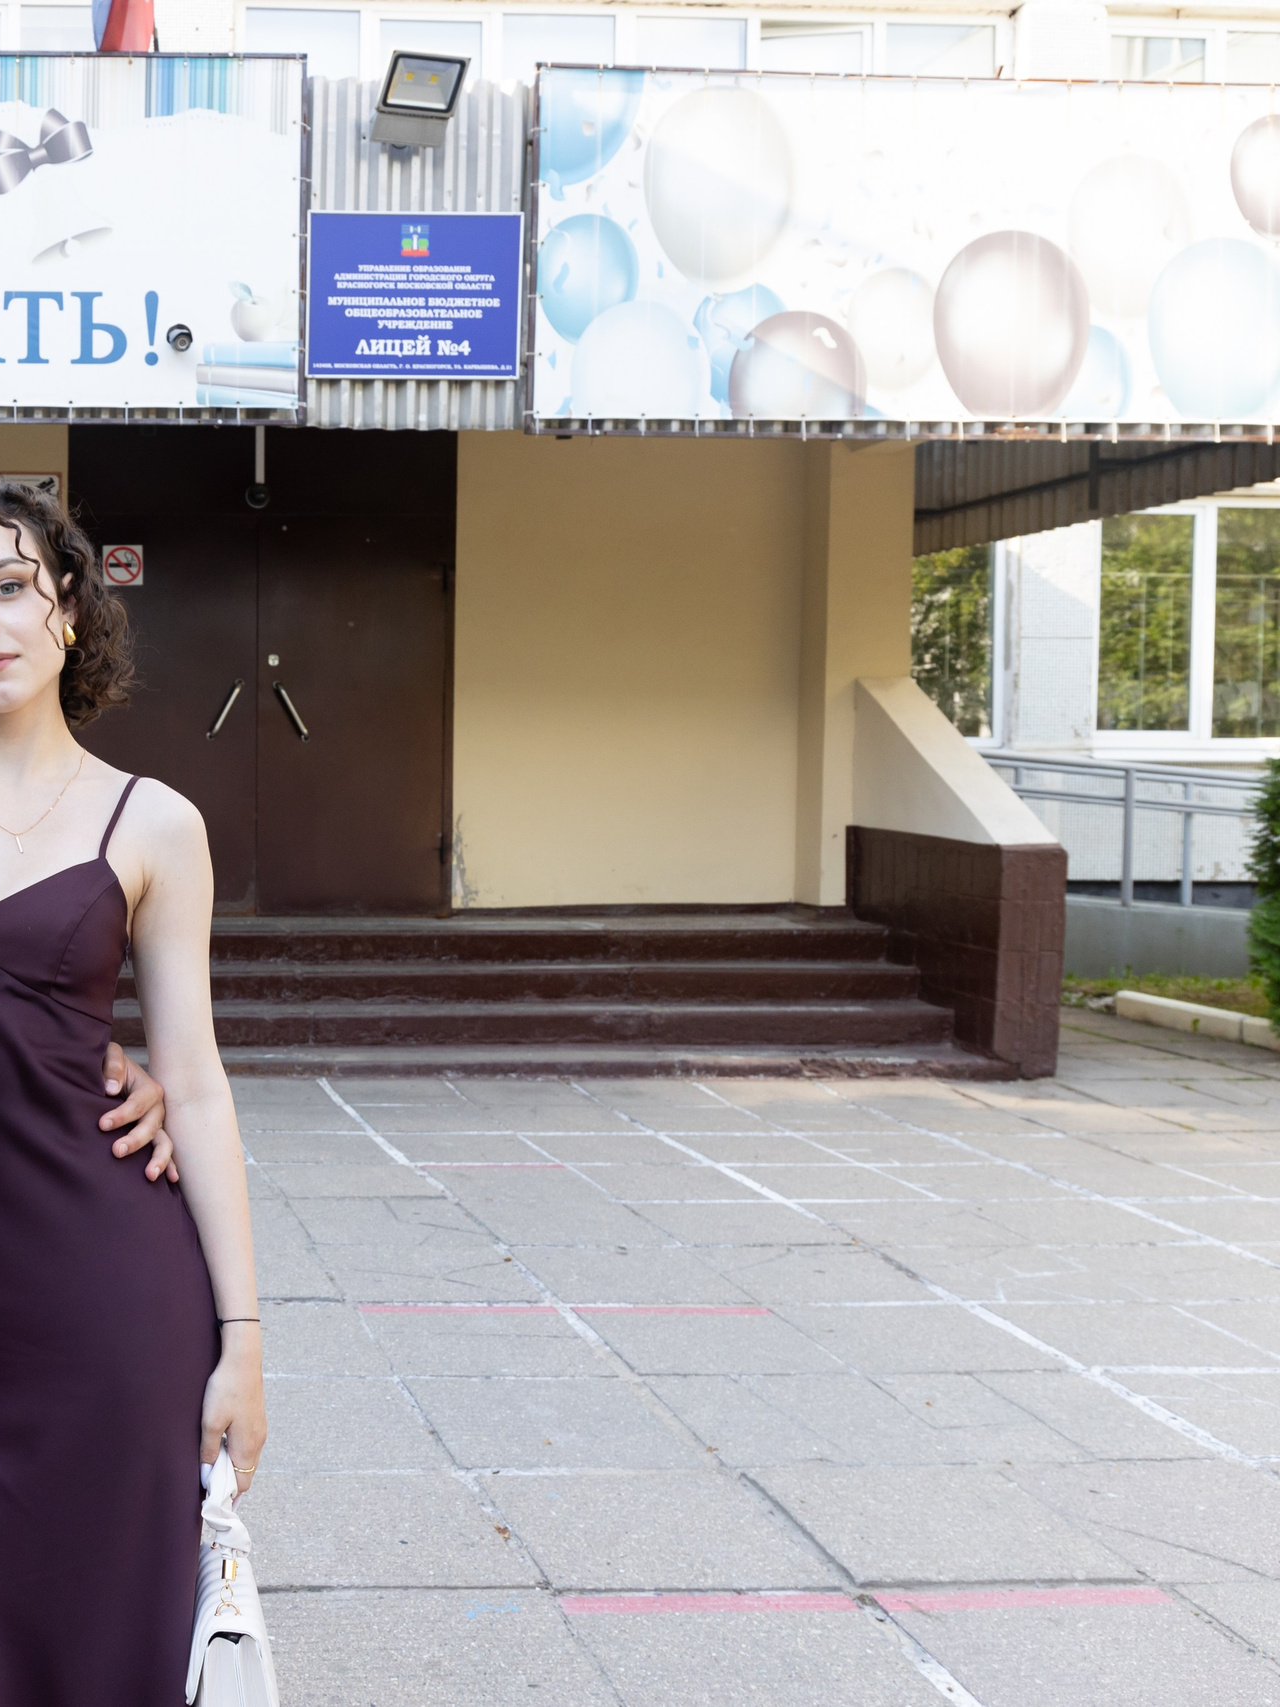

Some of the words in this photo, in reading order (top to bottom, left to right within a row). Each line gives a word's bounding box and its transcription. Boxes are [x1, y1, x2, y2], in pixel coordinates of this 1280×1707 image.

[358, 264, 411, 272] УПРАВЛЕНИЕ
[412, 265, 471, 273] ОБРАЗОВАНИЯ
[408, 273, 462, 281] ГОРОДСКОГО
[464, 274, 495, 282] ОКРУГА
[337, 281, 395, 289] КРАСНОГОРСК
[397, 280, 453, 290] МОСКОВСКОЙ
[454, 282, 492, 290] ОБЛАСТИ
[327, 296, 425, 307] МУНИЦИПАЛЬНОЕ
[427, 297, 500, 307] БЮДЖЕТНОЕ
[345, 308, 483, 318] ОБЩЕОБРАЗОВАТЕЛЬНОЕ
[377, 320, 453, 330] УЧРЕЖДЕНИЕ
[355, 335, 431, 357] ЛИЦЕЙ
[437, 339, 471, 356] №4
